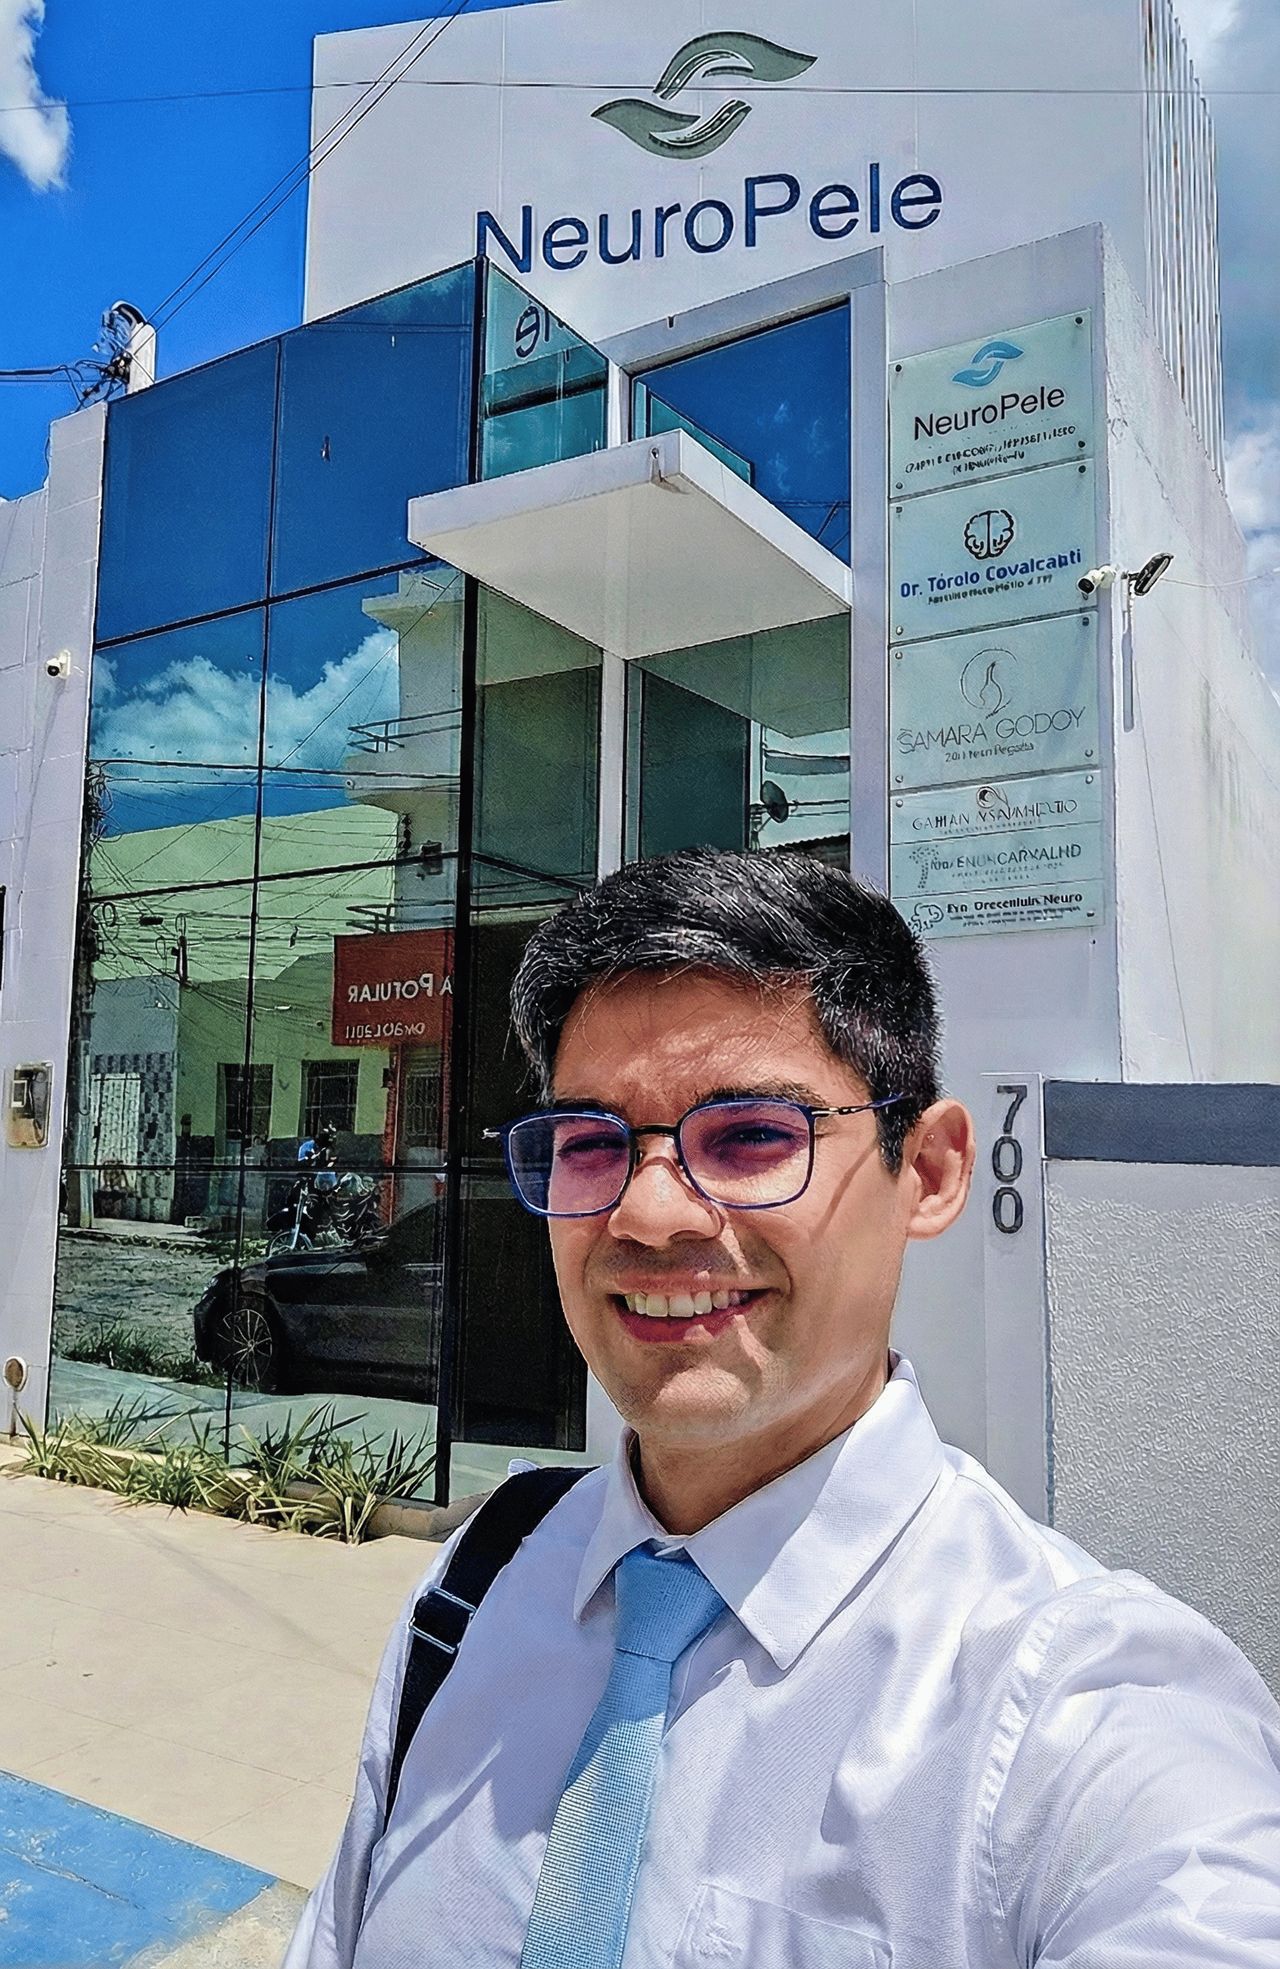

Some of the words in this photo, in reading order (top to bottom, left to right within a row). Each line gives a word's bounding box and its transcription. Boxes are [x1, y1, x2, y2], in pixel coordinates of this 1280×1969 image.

[477, 162, 942, 273] NeuroPele
[914, 386, 1065, 440] NeuroPele
[996, 706, 1086, 738] GODOY
[992, 1085, 1028, 1234] 700
